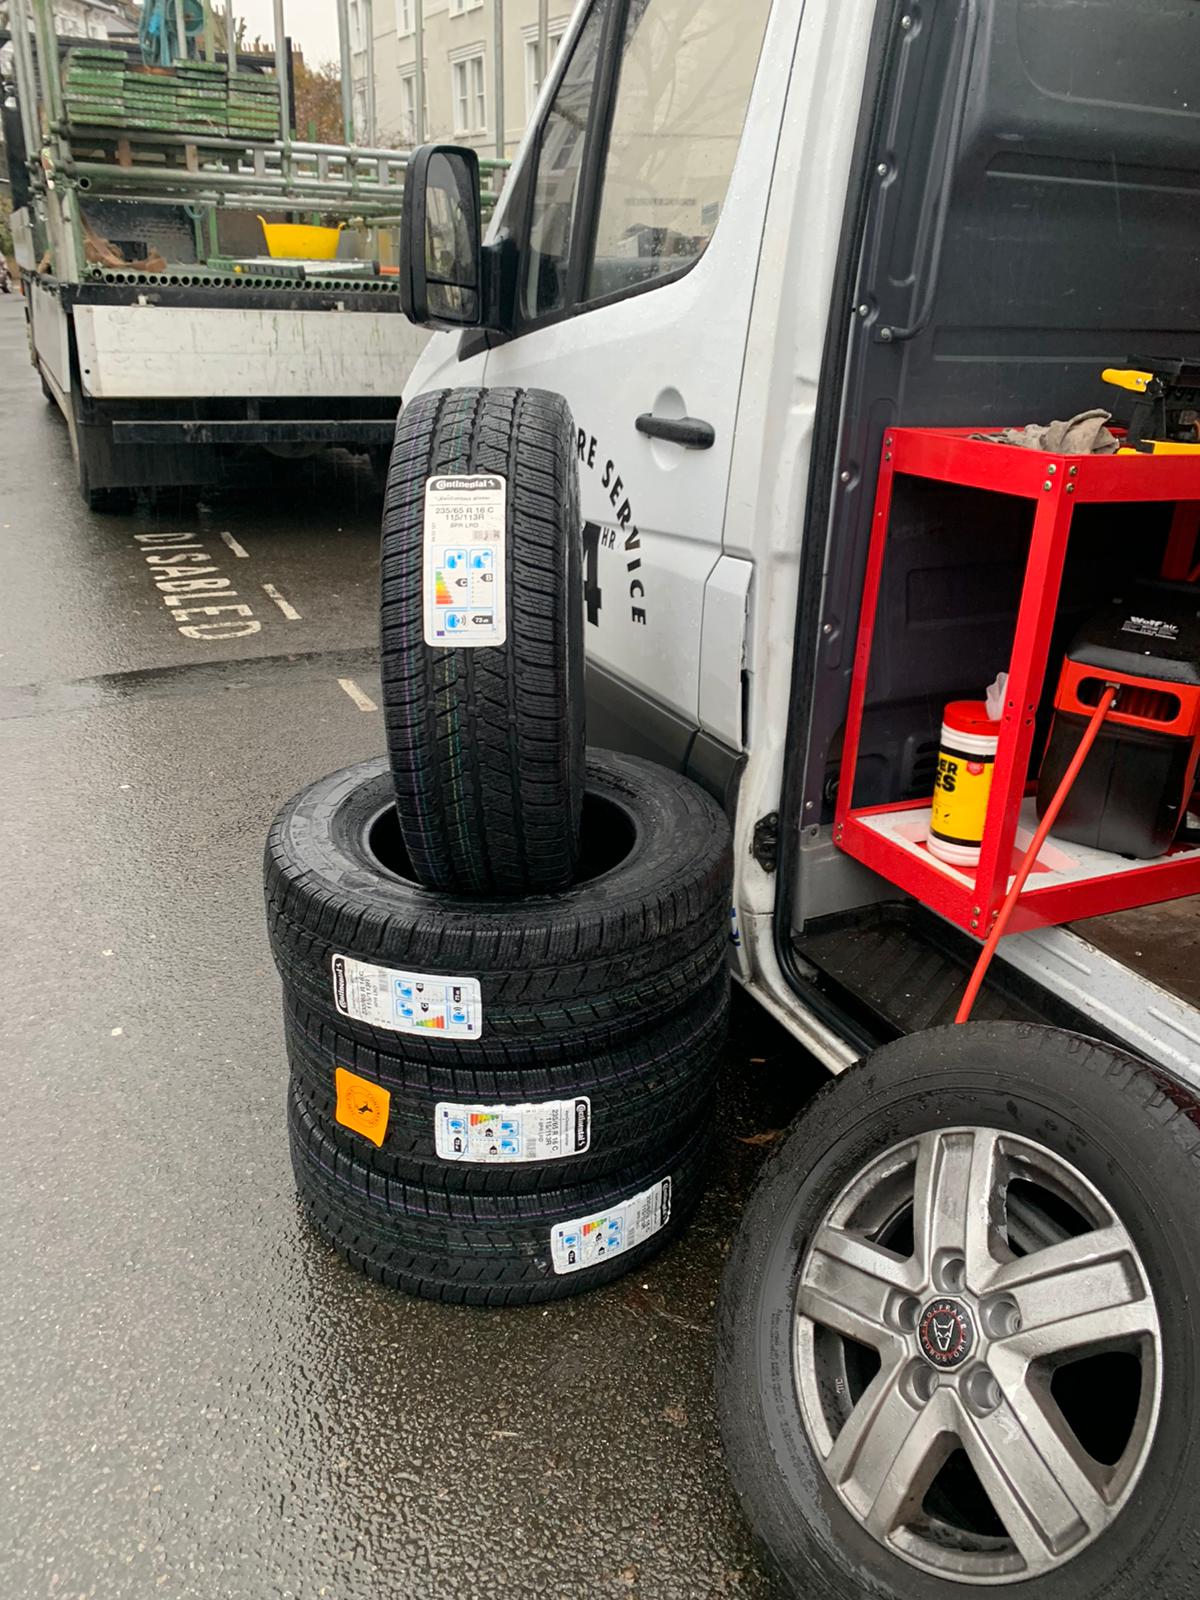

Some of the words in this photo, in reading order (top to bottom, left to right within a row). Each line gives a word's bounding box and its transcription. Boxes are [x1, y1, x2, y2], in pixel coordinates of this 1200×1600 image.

[436, 480, 487, 490] Continental
[601, 527, 616, 550] HR
[602, 459, 647, 626] SERVICE
[134, 533, 262, 640] DISABLED
[337, 969, 347, 1008] Continental
[576, 1103, 587, 1141] Continental
